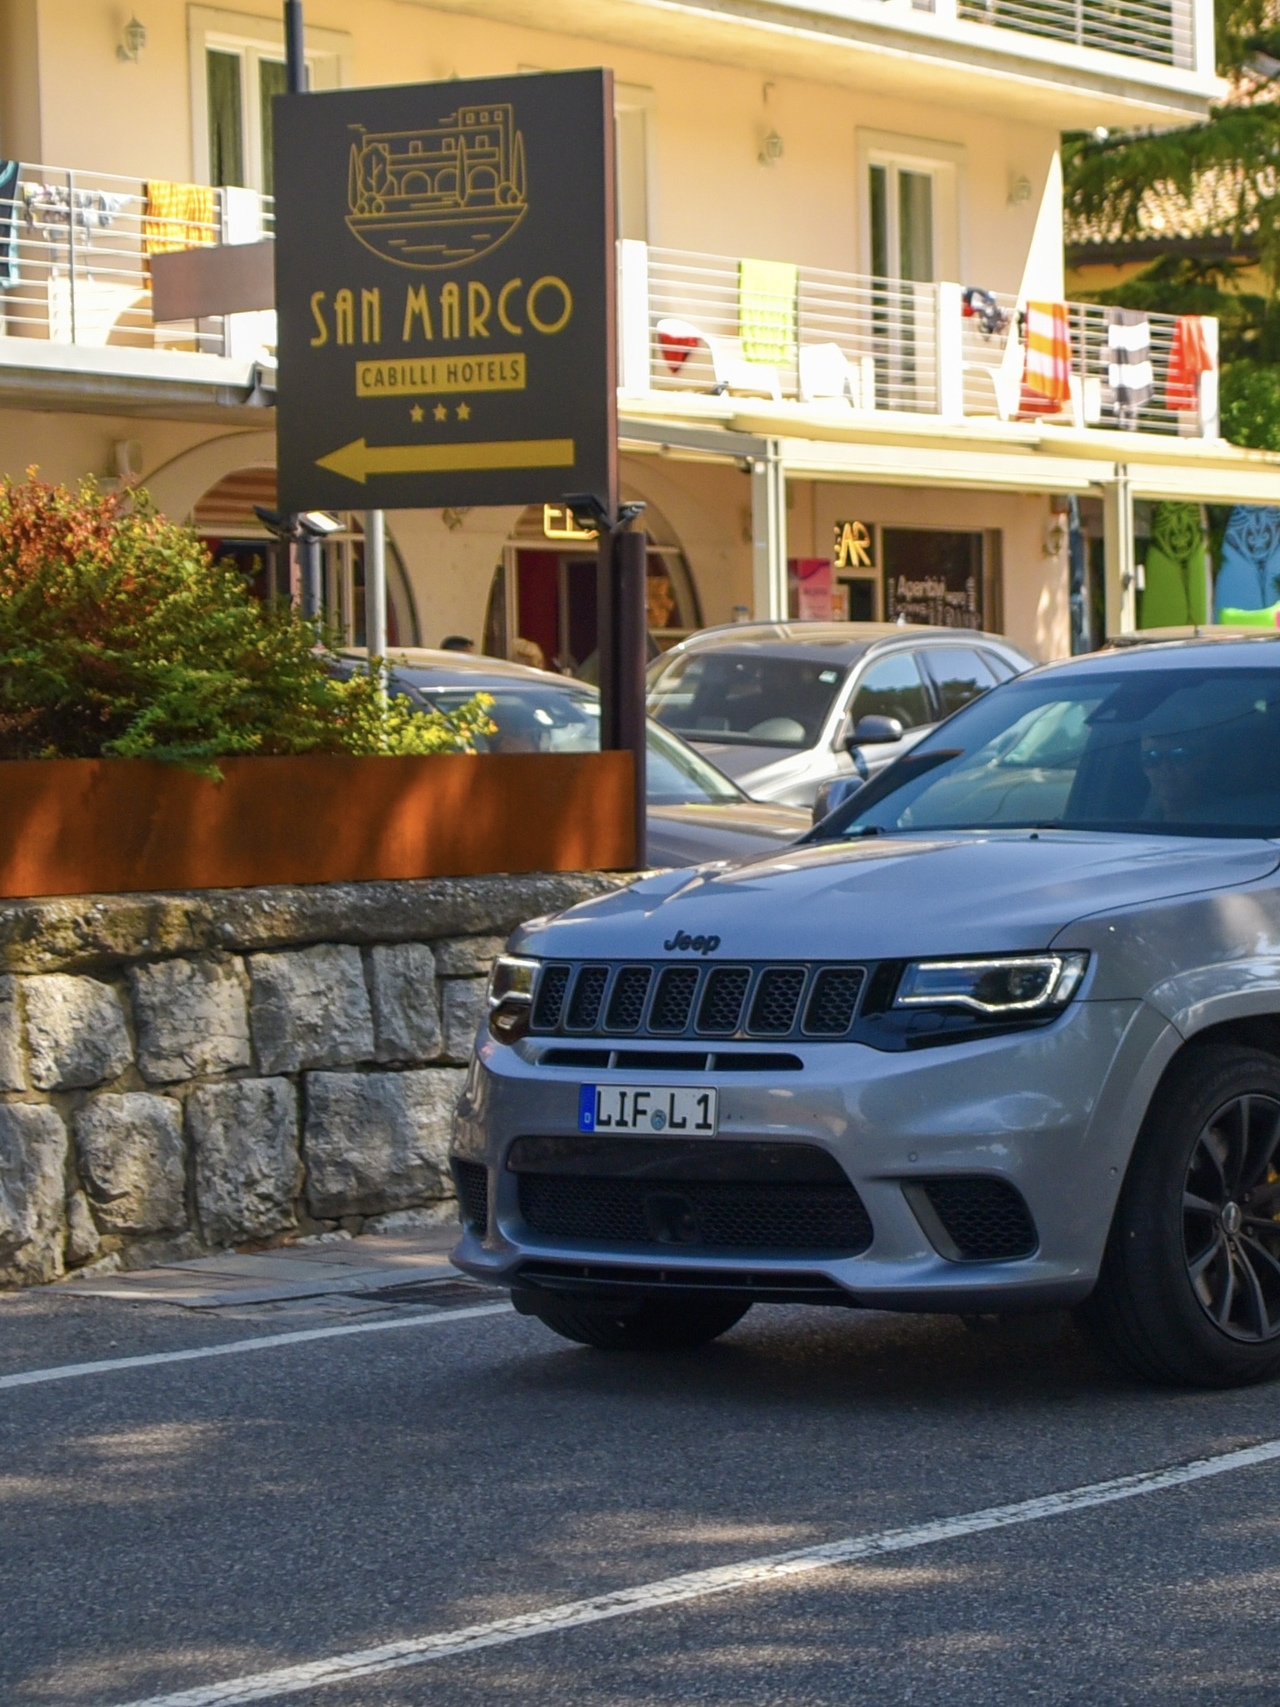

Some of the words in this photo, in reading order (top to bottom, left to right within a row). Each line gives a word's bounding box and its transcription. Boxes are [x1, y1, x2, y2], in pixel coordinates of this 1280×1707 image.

[310, 286, 381, 347] SAN
[402, 275, 573, 343] MARCO
[361, 363, 437, 389] CABILLI
[447, 358, 521, 385] HOTELS
[664, 930, 721, 956] Jeep
[596, 1090, 651, 1128] LIF
